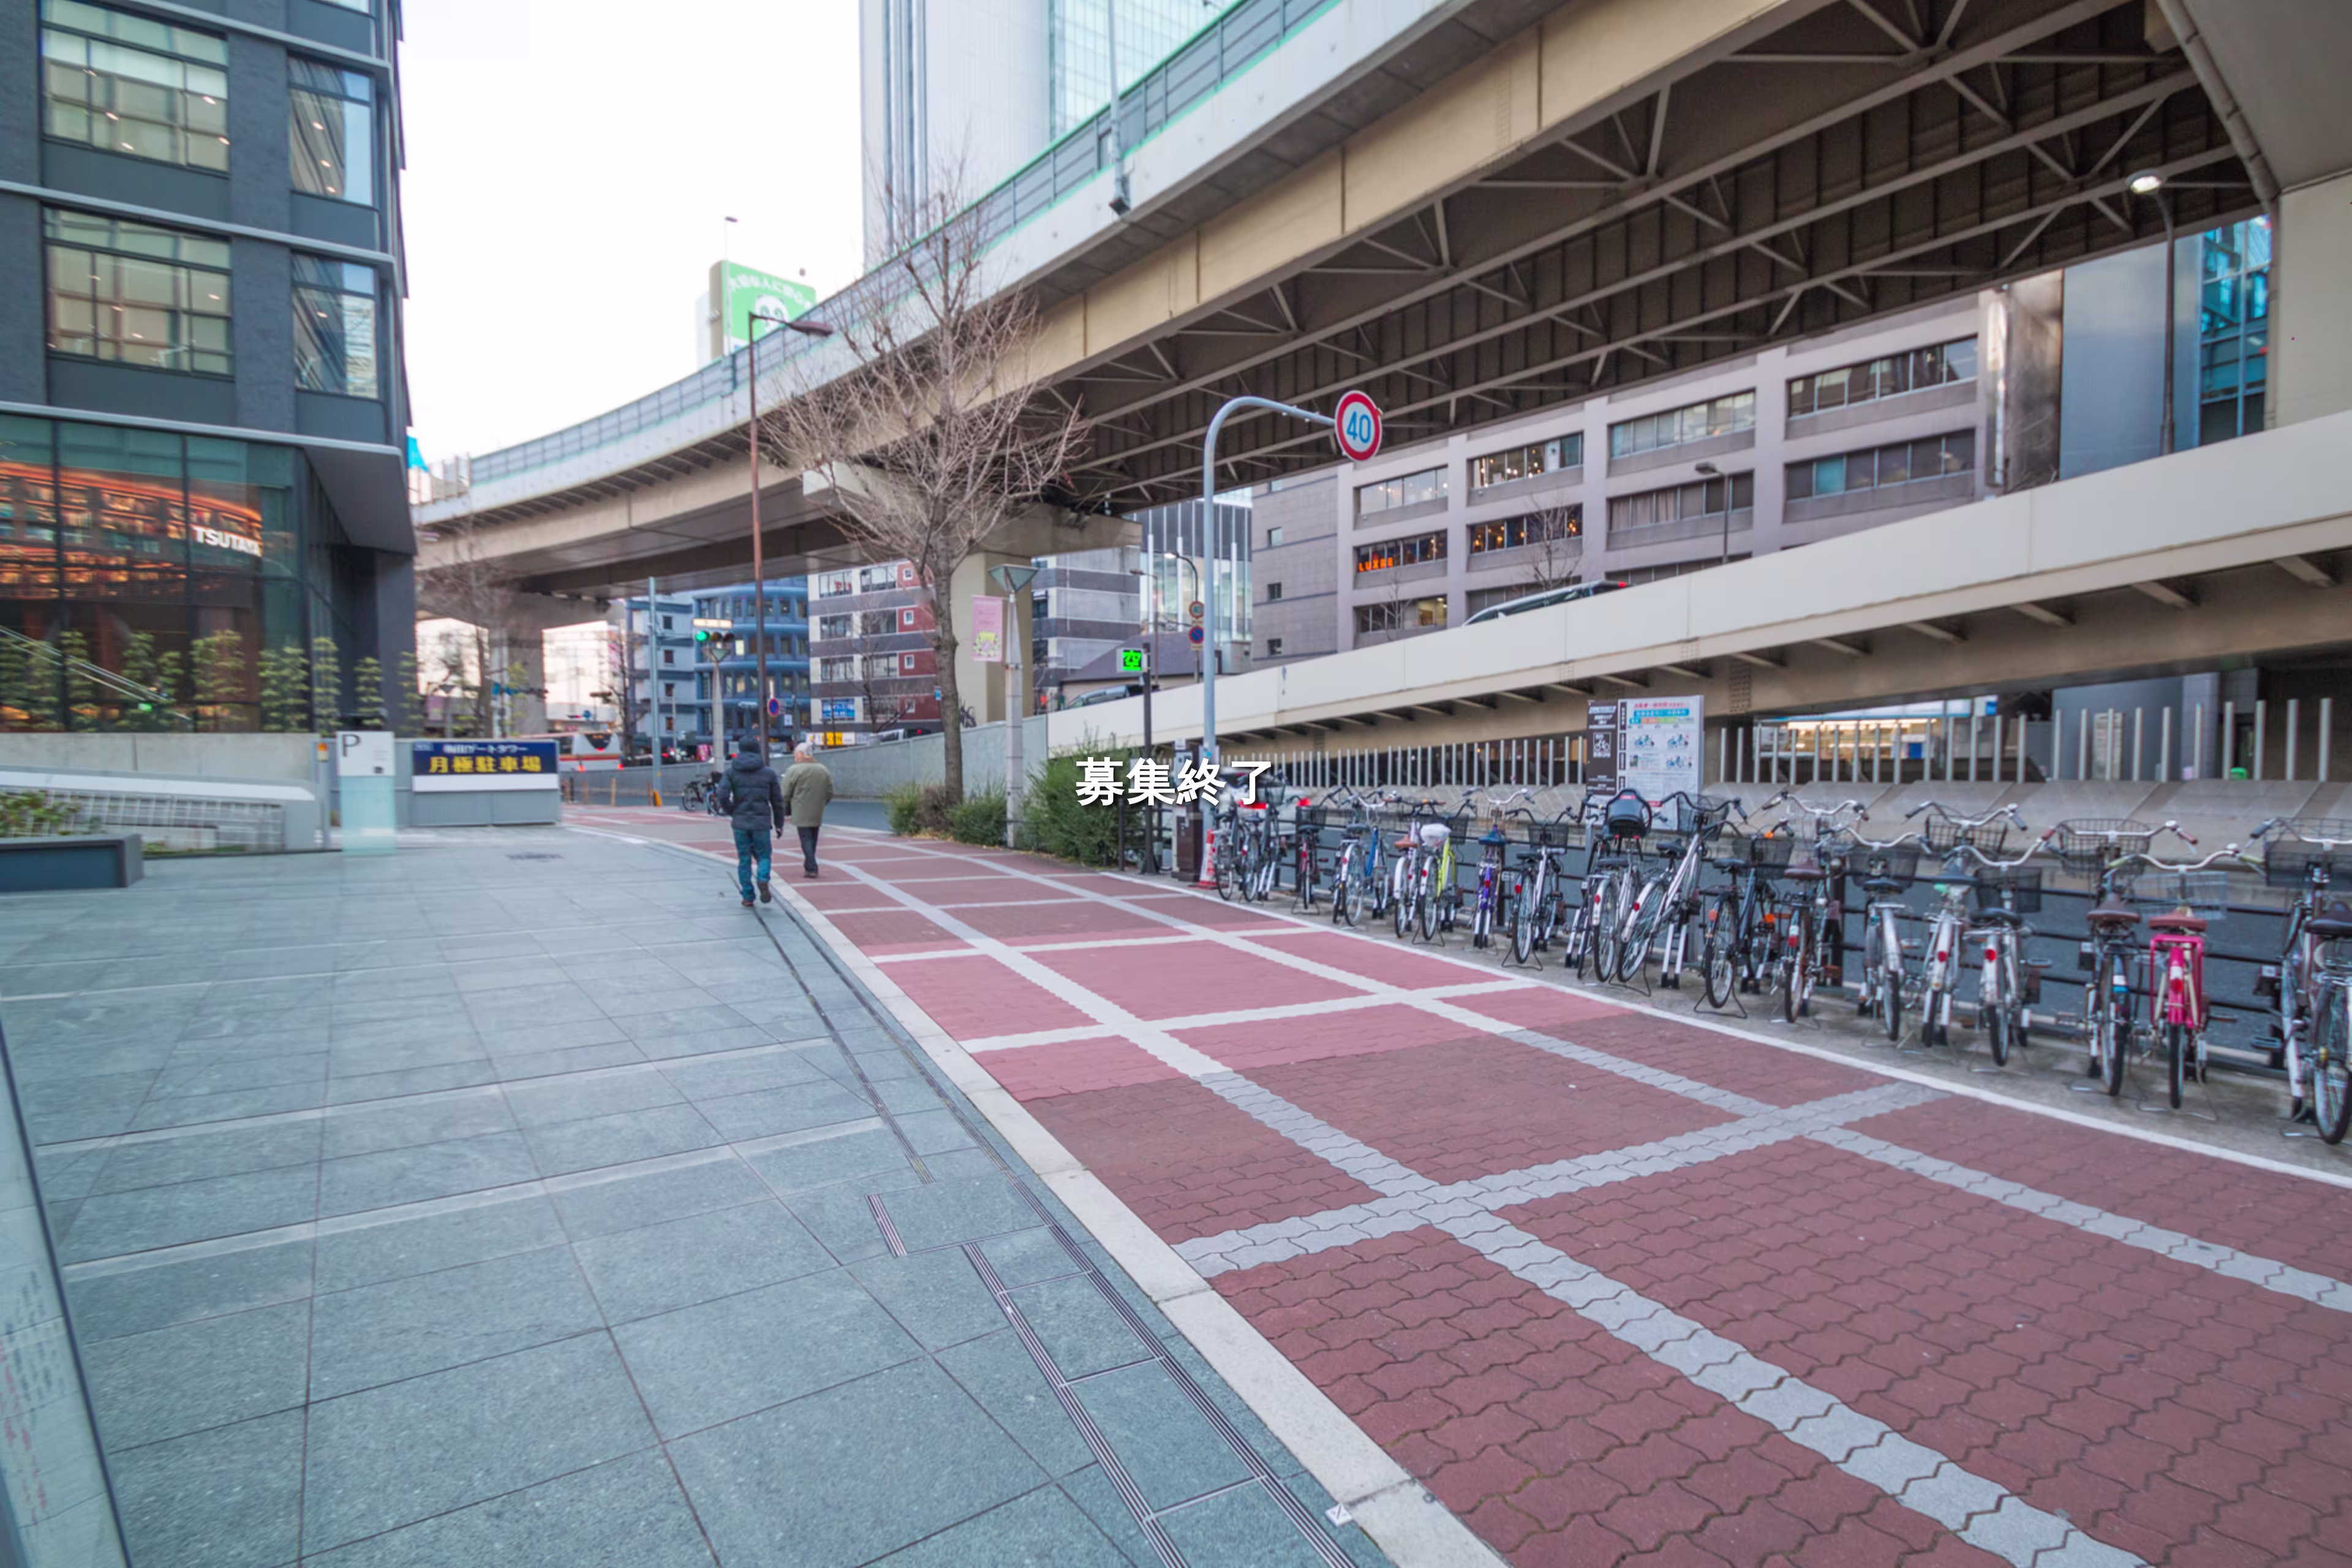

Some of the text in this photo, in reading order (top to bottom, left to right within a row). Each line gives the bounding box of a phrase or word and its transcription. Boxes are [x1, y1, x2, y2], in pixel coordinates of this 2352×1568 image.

[1346, 411, 1371, 443] 40
[192, 526, 263, 557] TSUTAYA
[1122, 649, 1142, 671] 空
[342, 733, 361, 758] P
[429, 755, 542, 774] 月極駐車場
